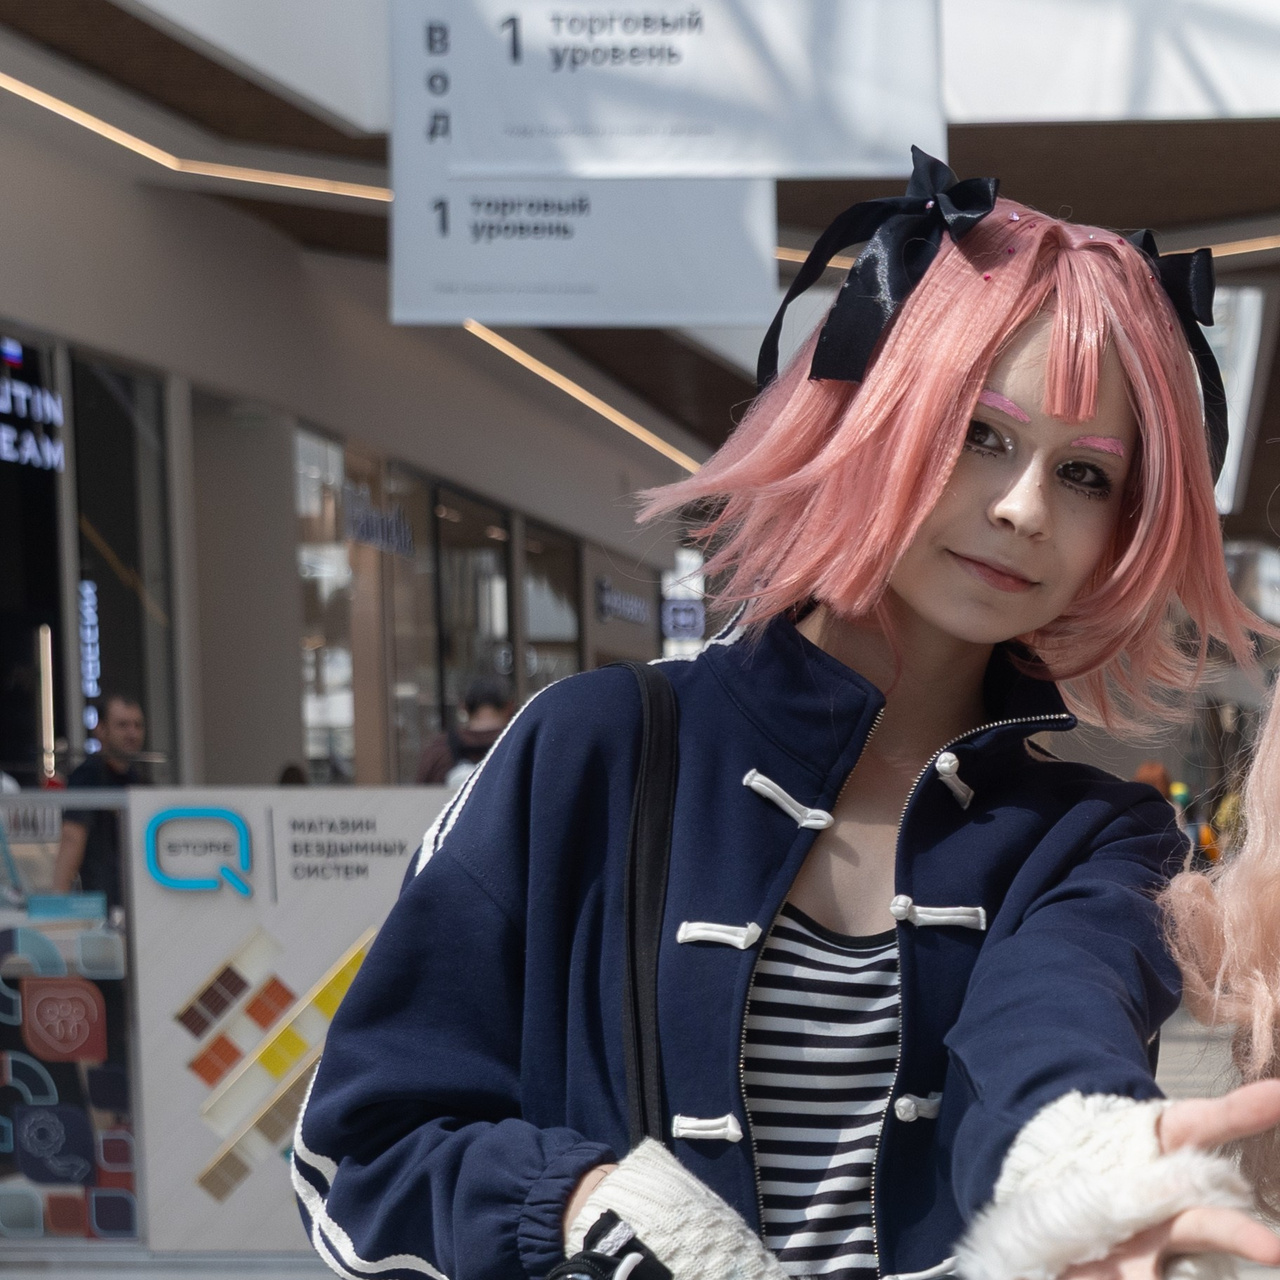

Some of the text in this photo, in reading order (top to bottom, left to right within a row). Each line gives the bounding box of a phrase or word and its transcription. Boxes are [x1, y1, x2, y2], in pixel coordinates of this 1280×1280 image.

[550, 6, 704, 42] торговый
[501, 15, 523, 66] 1
[550, 46, 682, 73] уровень
[433, 198, 450, 238] 1
[470, 195, 591, 221] торговый
[470, 222, 574, 244] уровень
[290, 818, 377, 834] МАГАЗИН
[290, 841, 408, 858] БЕЗДЫМНЫХ
[292, 863, 370, 880] СИСТЕМ
